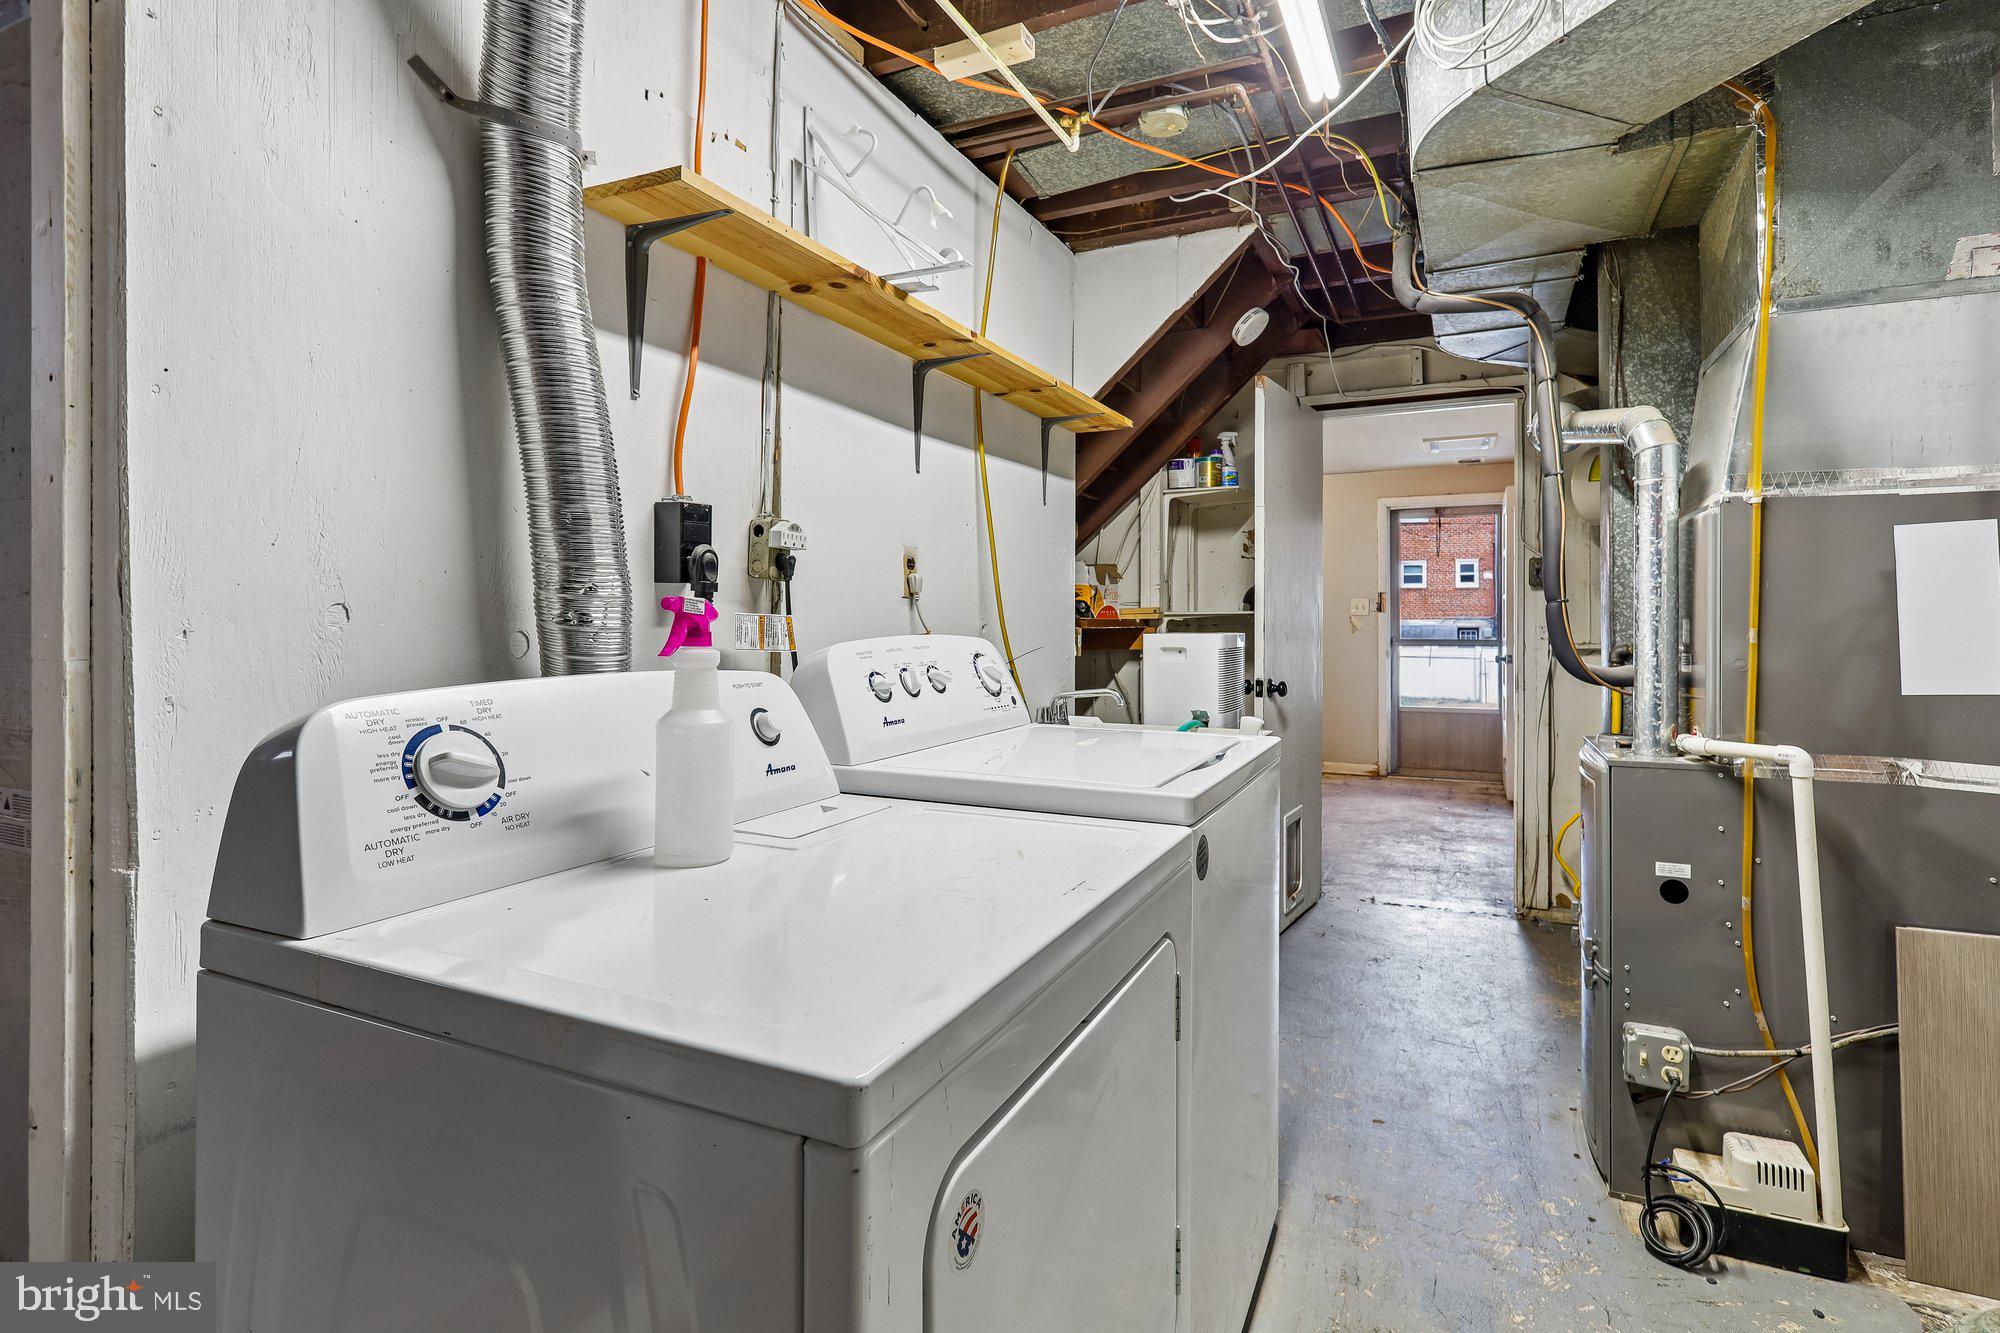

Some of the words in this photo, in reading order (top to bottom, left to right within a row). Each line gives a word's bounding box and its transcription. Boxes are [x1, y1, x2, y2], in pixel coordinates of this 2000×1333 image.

[469, 699, 493, 707] TIMED
[344, 708, 400, 719] AUTOMATIC
[882, 716, 905, 728] Amana
[369, 765, 398, 774] preferred
[765, 763, 796, 777] Amana
[501, 815, 514, 824] AIR
[514, 812, 530, 821] DRY
[390, 825, 411, 833] energy
[412, 819, 440, 829] preferred
[469, 821, 483, 829] OFF
[515, 821, 530, 829] HEAT
[364, 834, 421, 852] AUTOMATIC
[384, 847, 404, 858] DRY
[378, 860, 395, 869] LOW
[396, 855, 415, 864] HEAT
